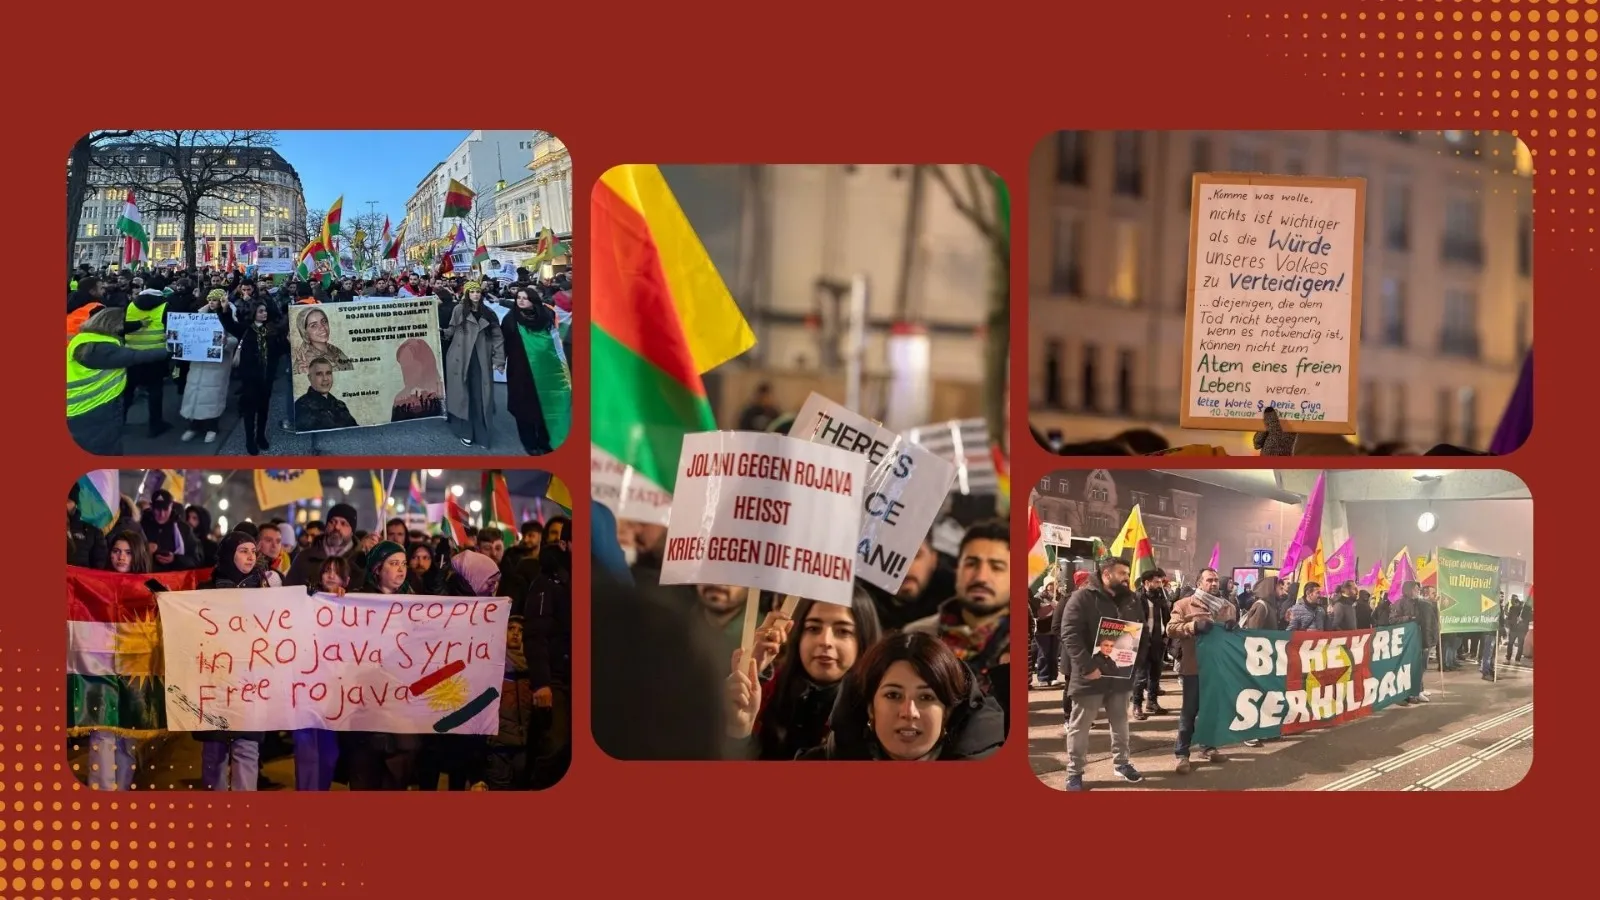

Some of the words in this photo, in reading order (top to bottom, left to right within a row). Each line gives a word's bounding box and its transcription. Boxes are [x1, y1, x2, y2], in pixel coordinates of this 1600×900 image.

[1210, 209, 1246, 222] nichts
[1254, 210, 1273, 225] ist
[1280, 215, 1340, 234] wichtiger
[1210, 230, 1228, 243] als
[1238, 232, 1257, 246] die
[1268, 229, 1332, 256] Würde
[1206, 251, 1265, 269] unseres
[1276, 252, 1328, 275] Volkes
[1203, 275, 1220, 288] zu
[1212, 298, 1273, 312] diejenigen,
[1278, 300, 1294, 309] die
[1299, 299, 1323, 309] dem
[349, 325, 396, 335] SOLIDARITÄT
[1200, 311, 1224, 324] Tod
[1230, 313, 1260, 325] nicht
[1266, 315, 1321, 328] begegnen,
[352, 334, 395, 342] PROTESTEN
[1200, 339, 1241, 351] können
[1245, 340, 1276, 353] nicht
[1280, 345, 1308, 354] zum
[1207, 327, 1236, 336] wenn
[1241, 328, 1254, 337] es
[1260, 328, 1322, 344] notwendig
[1325, 329, 1343, 340] ist,
[1197, 353, 1243, 373] Atem
[1252, 360, 1288, 373] eines
[1296, 357, 1342, 378] freien
[1199, 375, 1251, 394] Lebens
[1224, 408, 1256, 417] Januar
[1225, 398, 1252, 409] Worte
[1270, 400, 1296, 409] Deniz
[1300, 401, 1321, 413] Çiya
[814, 412, 888, 466] THERE
[687, 453, 735, 477] JOLANI
[737, 454, 792, 482] GEGEN
[794, 462, 852, 496] ROJAVA
[733, 496, 792, 525] HEISST
[666, 537, 705, 561] KRIEG
[708, 537, 762, 564] GEGEN
[764, 542, 791, 569] DIE
[793, 548, 852, 582] FRAUEN
[1450, 573, 1458, 586] in
[1459, 575, 1492, 589] Rojava!
[199, 608, 293, 636] Save
[317, 605, 376, 628] our
[381, 601, 498, 634] people
[198, 642, 233, 674] in
[396, 631, 491, 675] Syria
[1244, 636, 1288, 676] BI
[199, 678, 270, 725] Free
[292, 677, 410, 721] rojava
[1229, 664, 1412, 731] SERHILDAN
